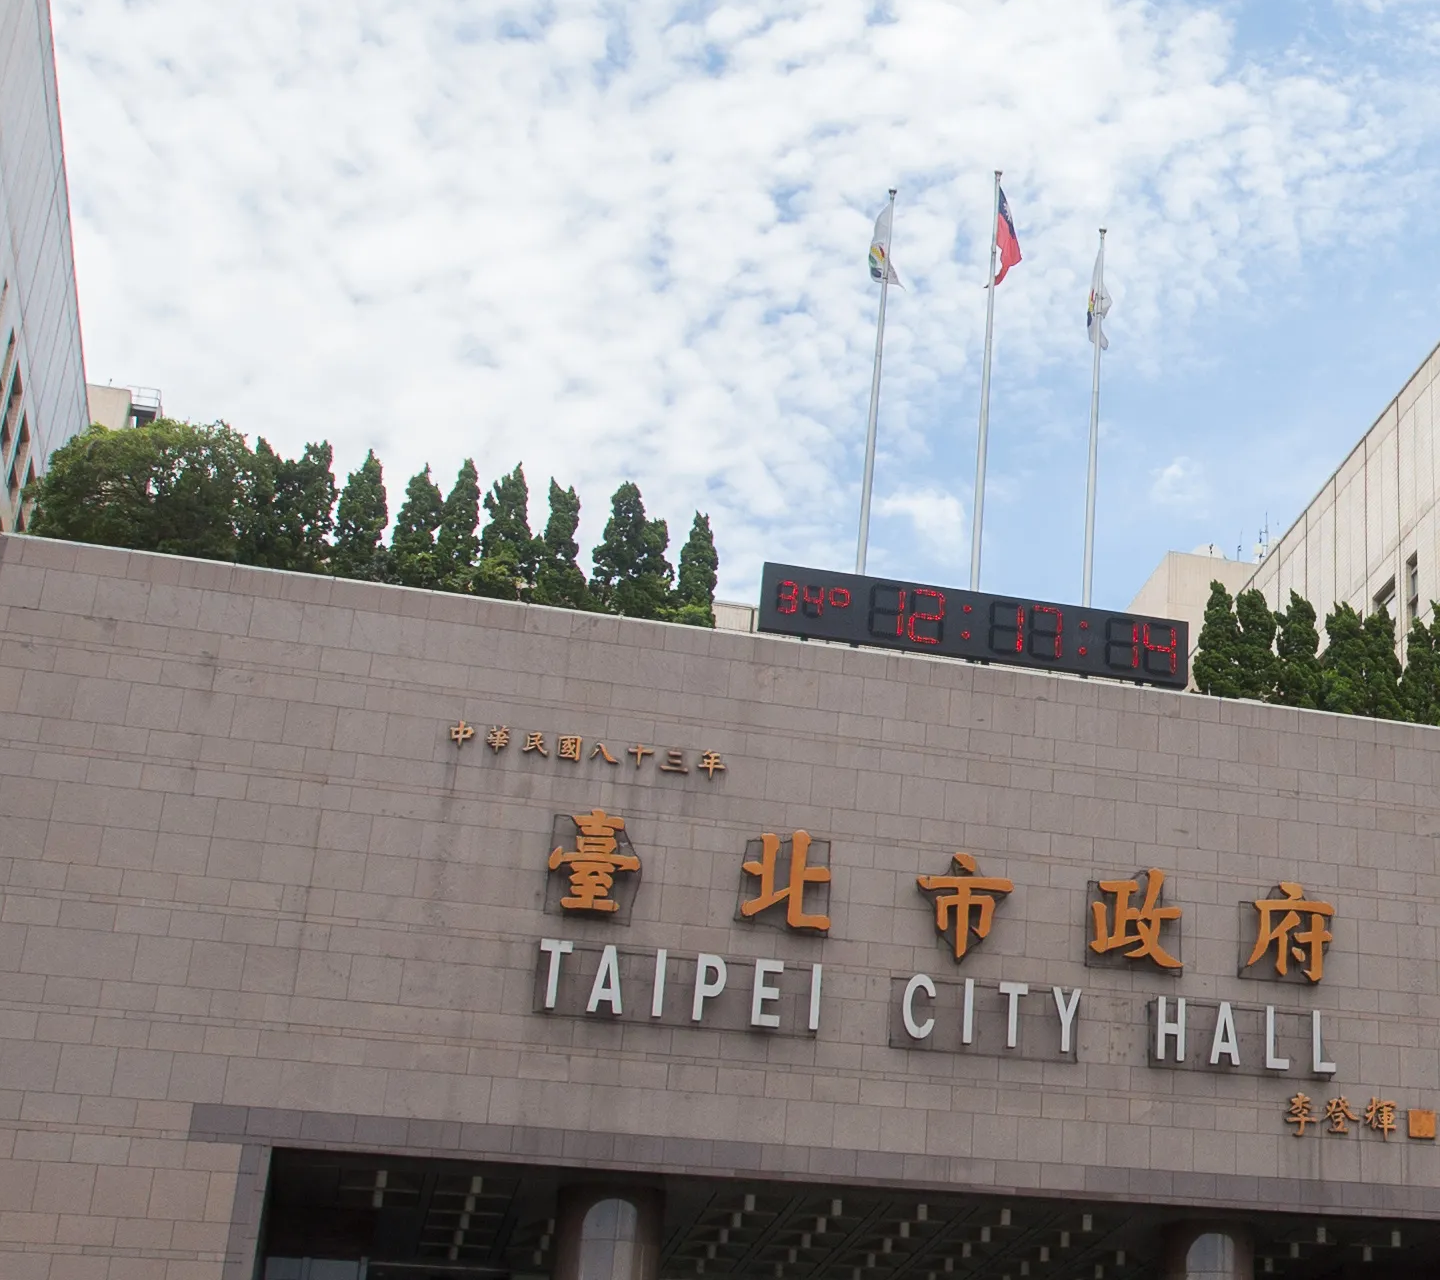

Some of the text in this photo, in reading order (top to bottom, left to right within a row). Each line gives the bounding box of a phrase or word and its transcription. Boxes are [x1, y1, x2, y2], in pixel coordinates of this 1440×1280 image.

[449, 720, 727, 780] 中華民國八十三年
[547, 808, 1336, 986] 臺北市政府
[538, 938, 1337, 1075] TAIPEI CITY HALL
[1285, 1092, 1398, 1142] 李登輝
